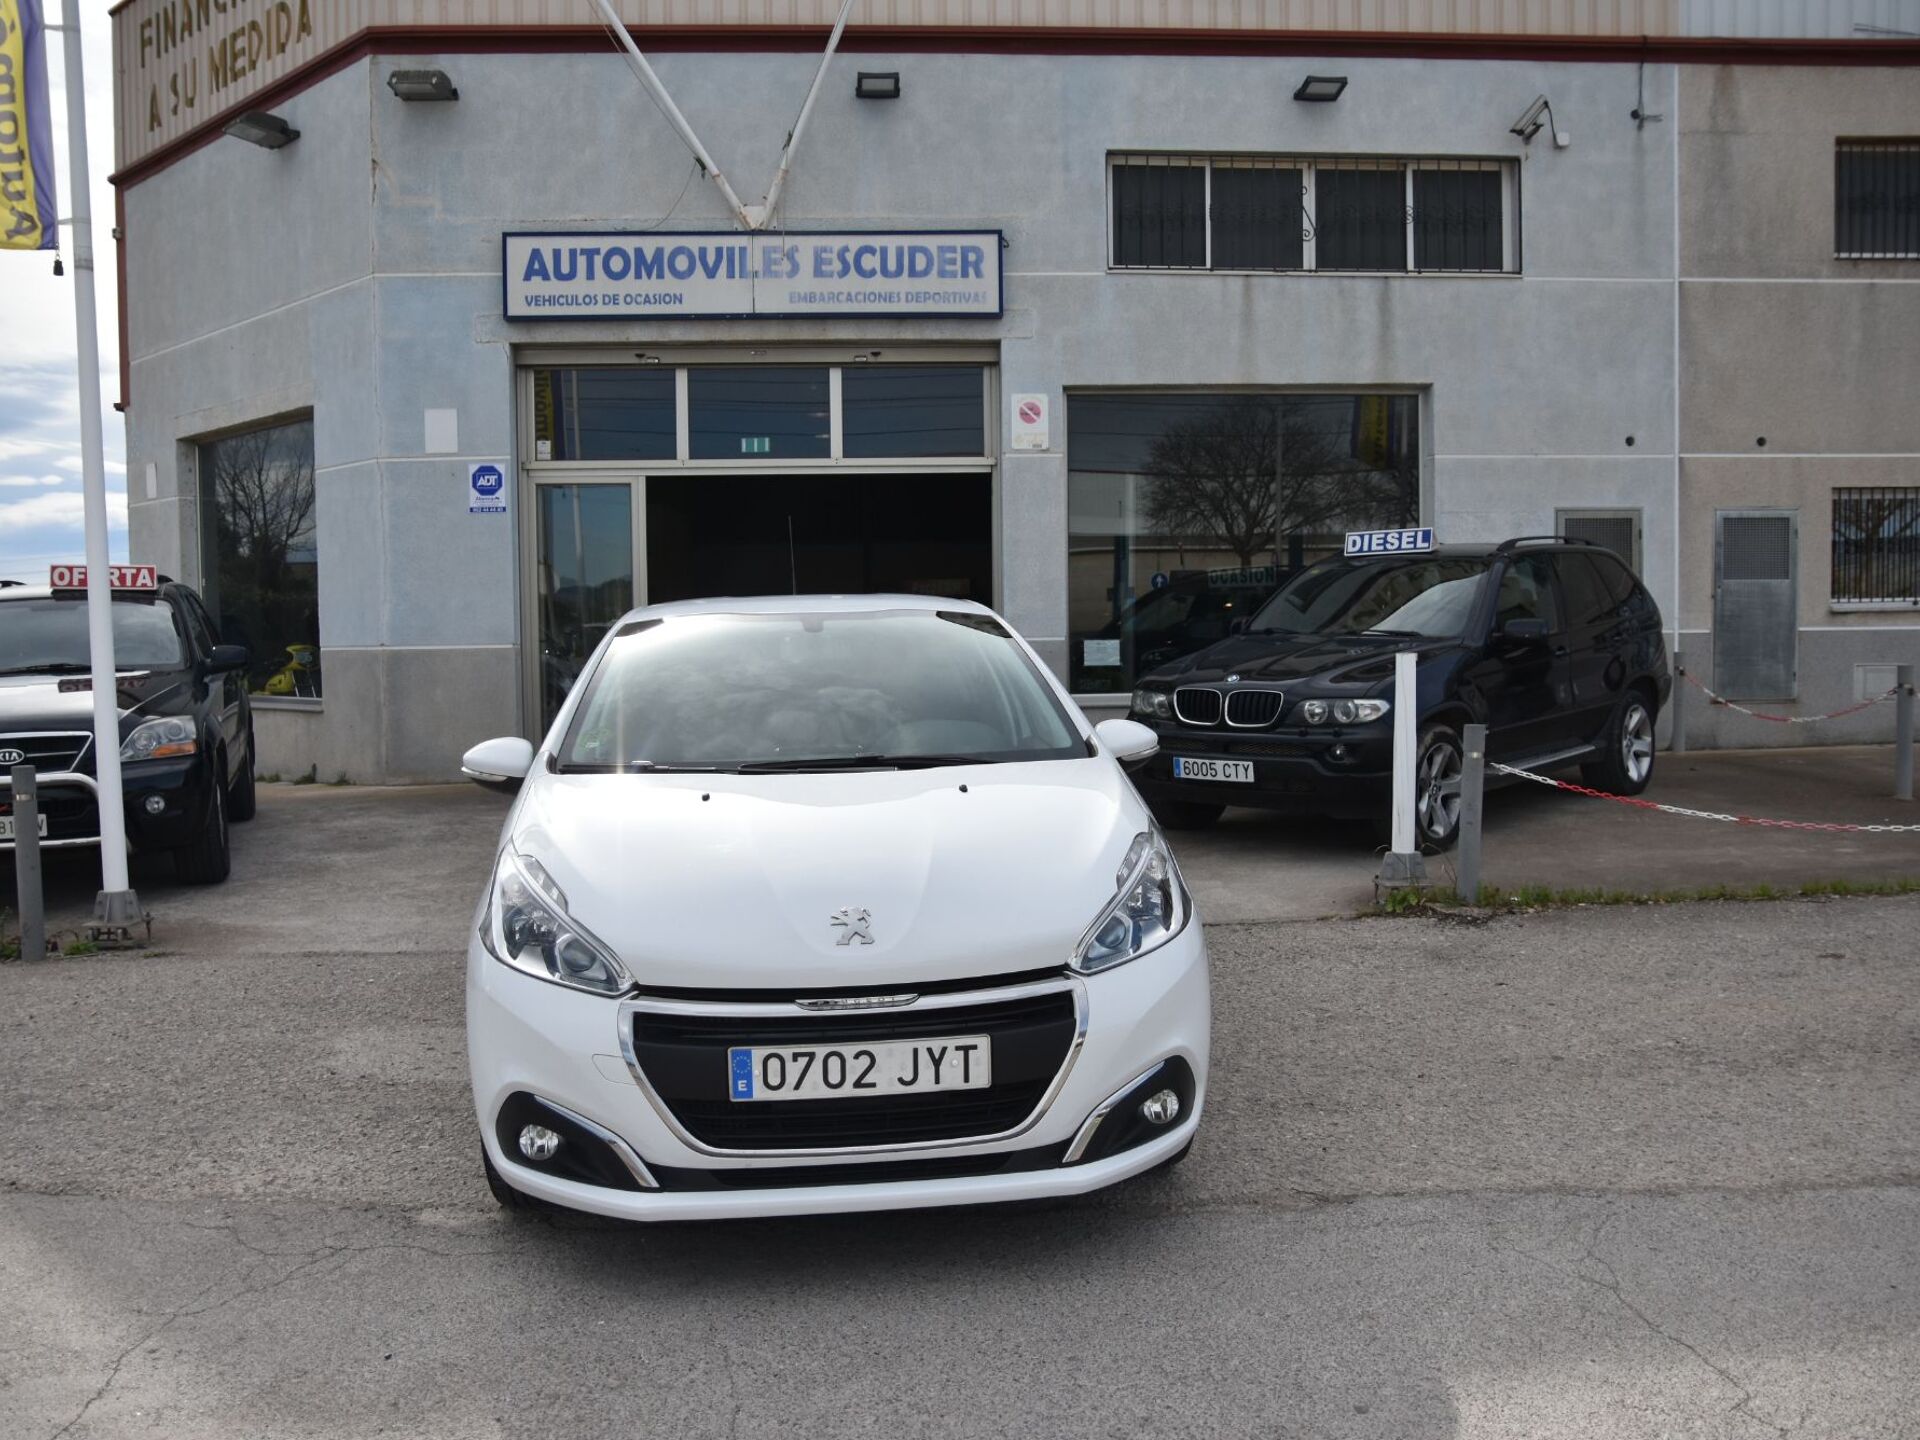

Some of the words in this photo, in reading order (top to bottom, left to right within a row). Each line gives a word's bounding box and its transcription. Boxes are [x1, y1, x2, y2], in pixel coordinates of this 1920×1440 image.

[149, 83, 162, 132] A
[170, 57, 197, 116] SU
[208, 0, 312, 95] MEDIDA
[522, 246, 799, 281] AUTOMOVILES
[813, 244, 985, 279] ESCUDER
[525, 294, 598, 307] VEHICULOS
[602, 294, 619, 305] DE
[623, 293, 683, 305] OCASION
[788, 291, 902, 304] EMBARCACIONES
[905, 291, 987, 304] DEPORTIVAS
[478, 475, 498, 486] ADT
[1347, 532, 1429, 552] DIESEL
[52, 567, 153, 587] OFRTA
[1210, 567, 1275, 585] OCASION
[1183, 760, 1218, 777] 6005
[1222, 763, 1250, 779] CTY
[738, 1080, 747, 1091] E
[762, 1050, 877, 1091] 0702
[897, 1044, 978, 1086] JYT
